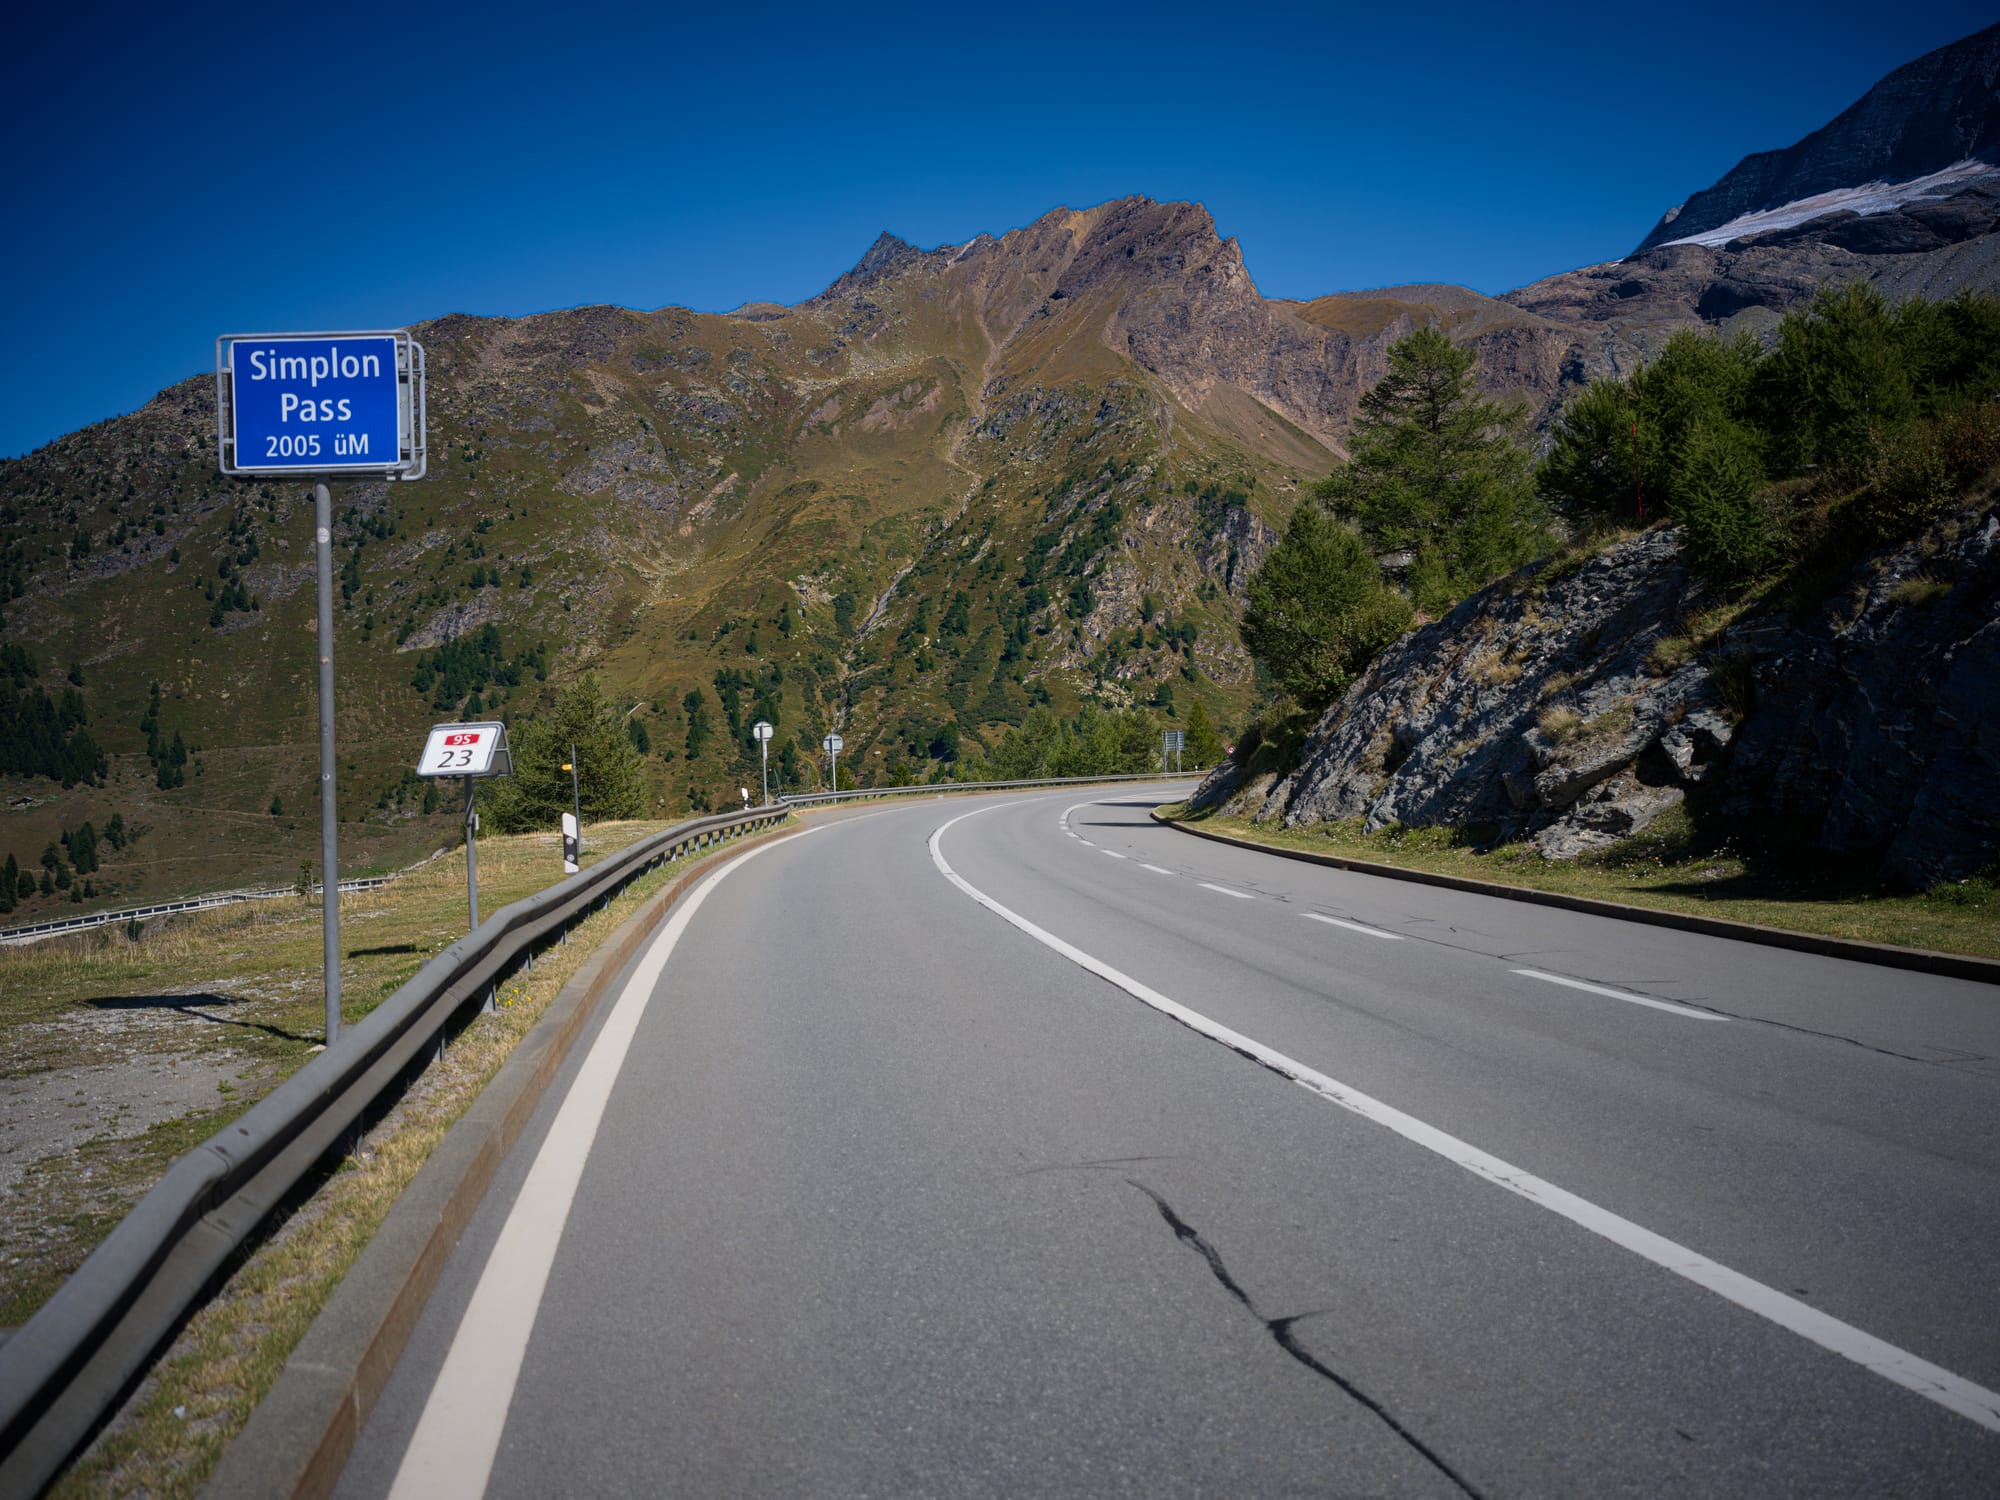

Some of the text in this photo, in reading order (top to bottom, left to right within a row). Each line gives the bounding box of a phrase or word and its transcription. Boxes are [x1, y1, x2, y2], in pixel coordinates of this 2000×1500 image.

[250, 347, 380, 387] Simplon
[281, 393, 352, 423] Pass
[266, 433, 369, 457] 2005 üM
[437, 749, 473, 768] 23
